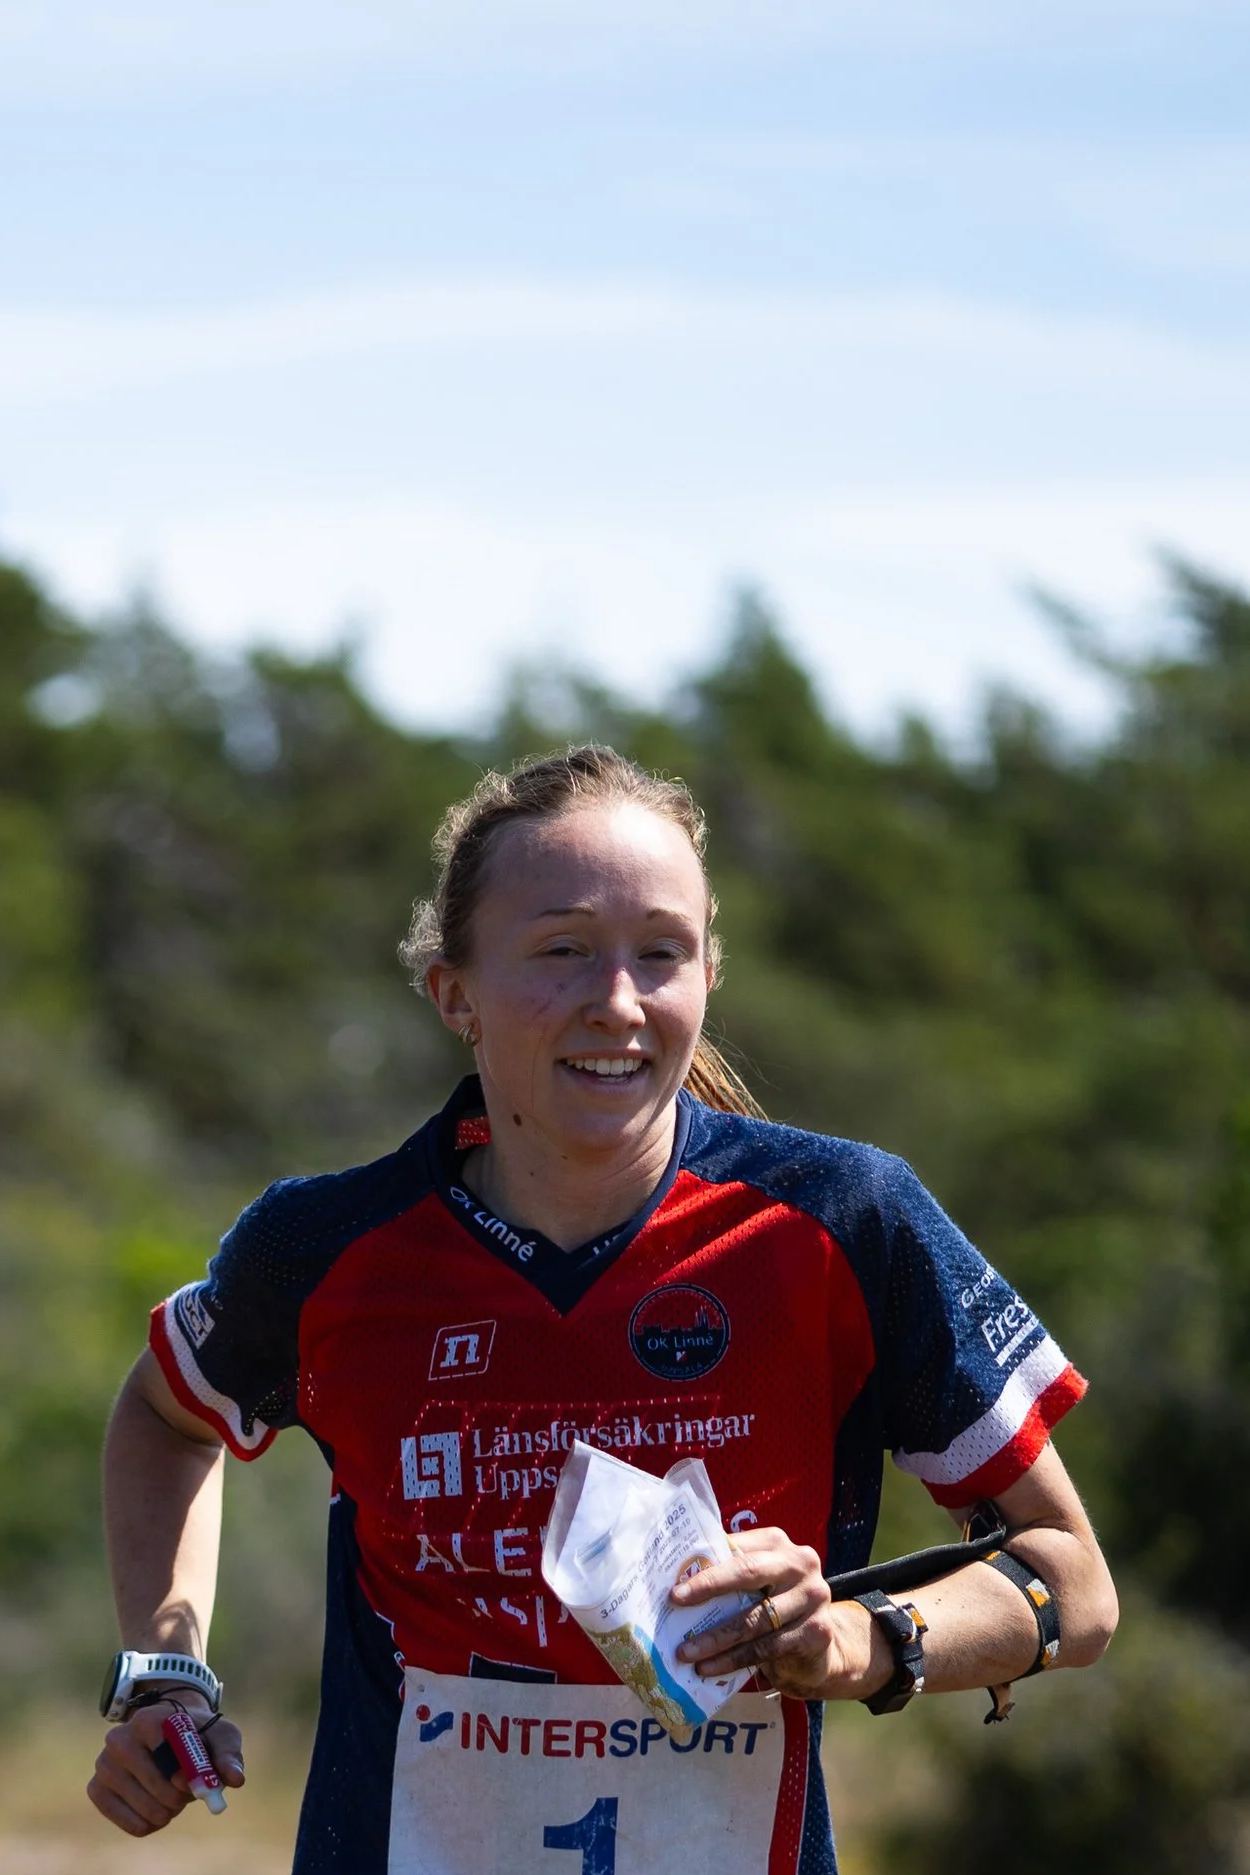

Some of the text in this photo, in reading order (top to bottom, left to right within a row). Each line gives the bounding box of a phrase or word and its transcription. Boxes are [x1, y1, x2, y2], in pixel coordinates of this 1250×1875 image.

[473, 1211, 537, 1262] Linné
[647, 1332, 714, 1351] OK Linné
[472, 1412, 756, 1459] Länsförsäkringar
[474, 1462, 564, 1501] Upps
[663, 1503, 687, 1531] 2025
[461, 1711, 768, 1758] INTERSPORT
